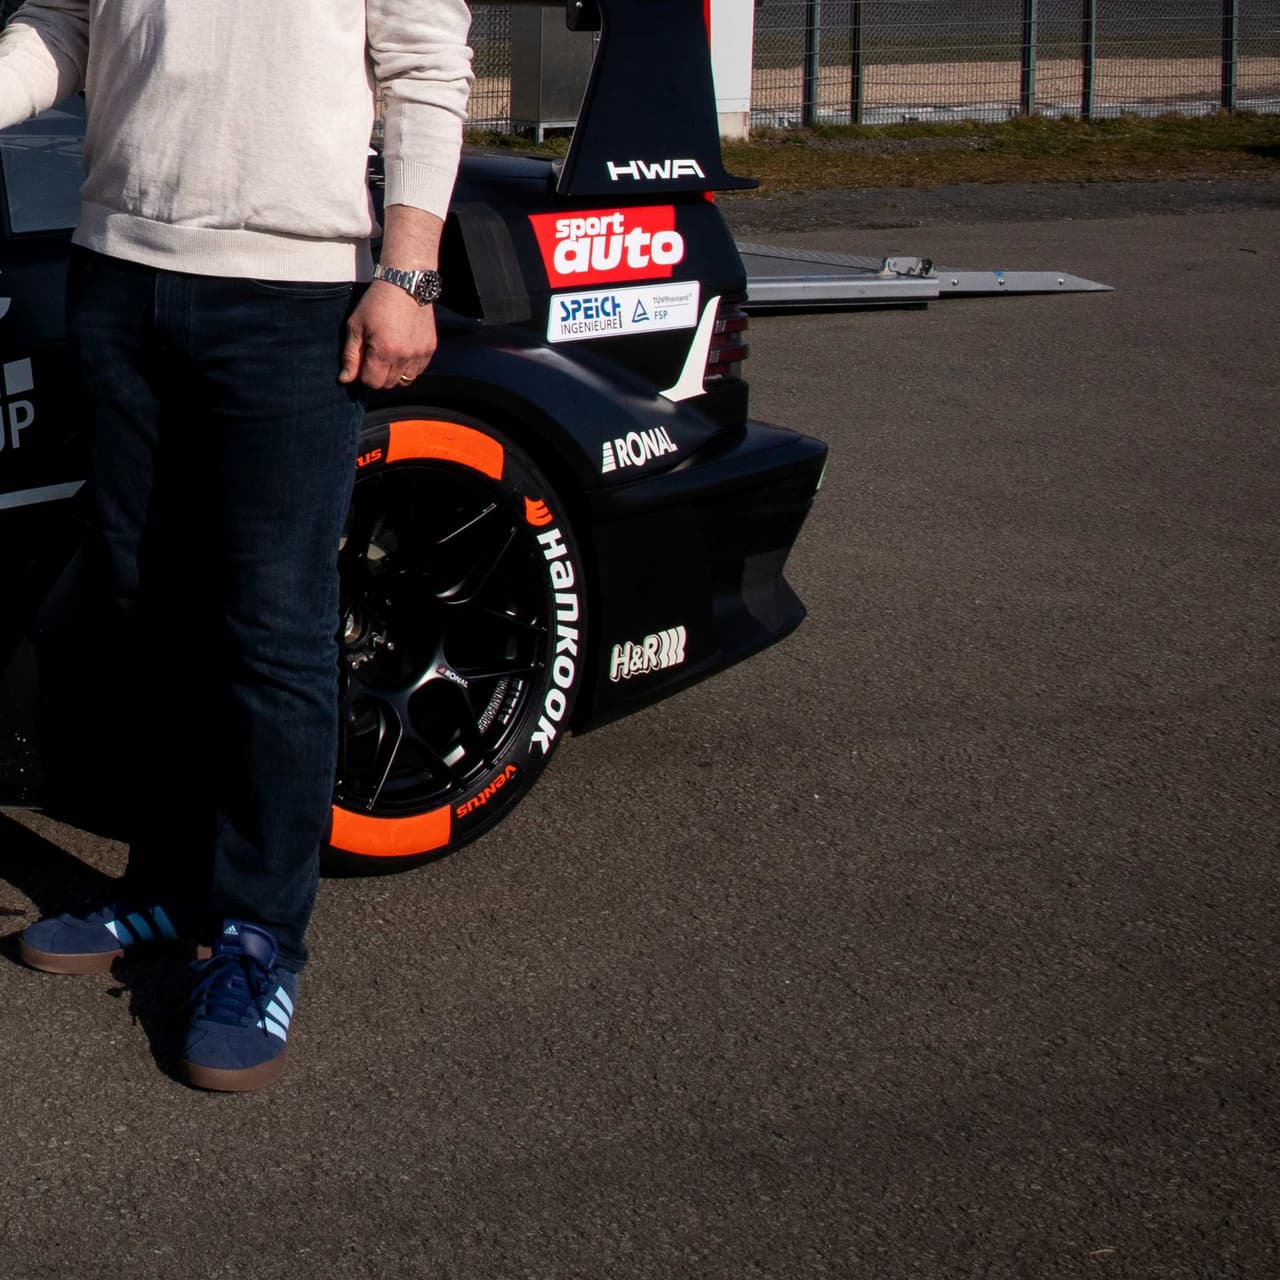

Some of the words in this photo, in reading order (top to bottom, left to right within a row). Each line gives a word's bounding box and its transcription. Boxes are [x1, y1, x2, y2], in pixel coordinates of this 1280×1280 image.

[606, 158, 706, 182] HWA
[555, 211, 625, 239] sport
[553, 225, 685, 275] auto
[560, 318, 619, 336] INGENIEURE
[653, 310, 668, 321] FSP
[614, 425, 679, 468] RONAL
